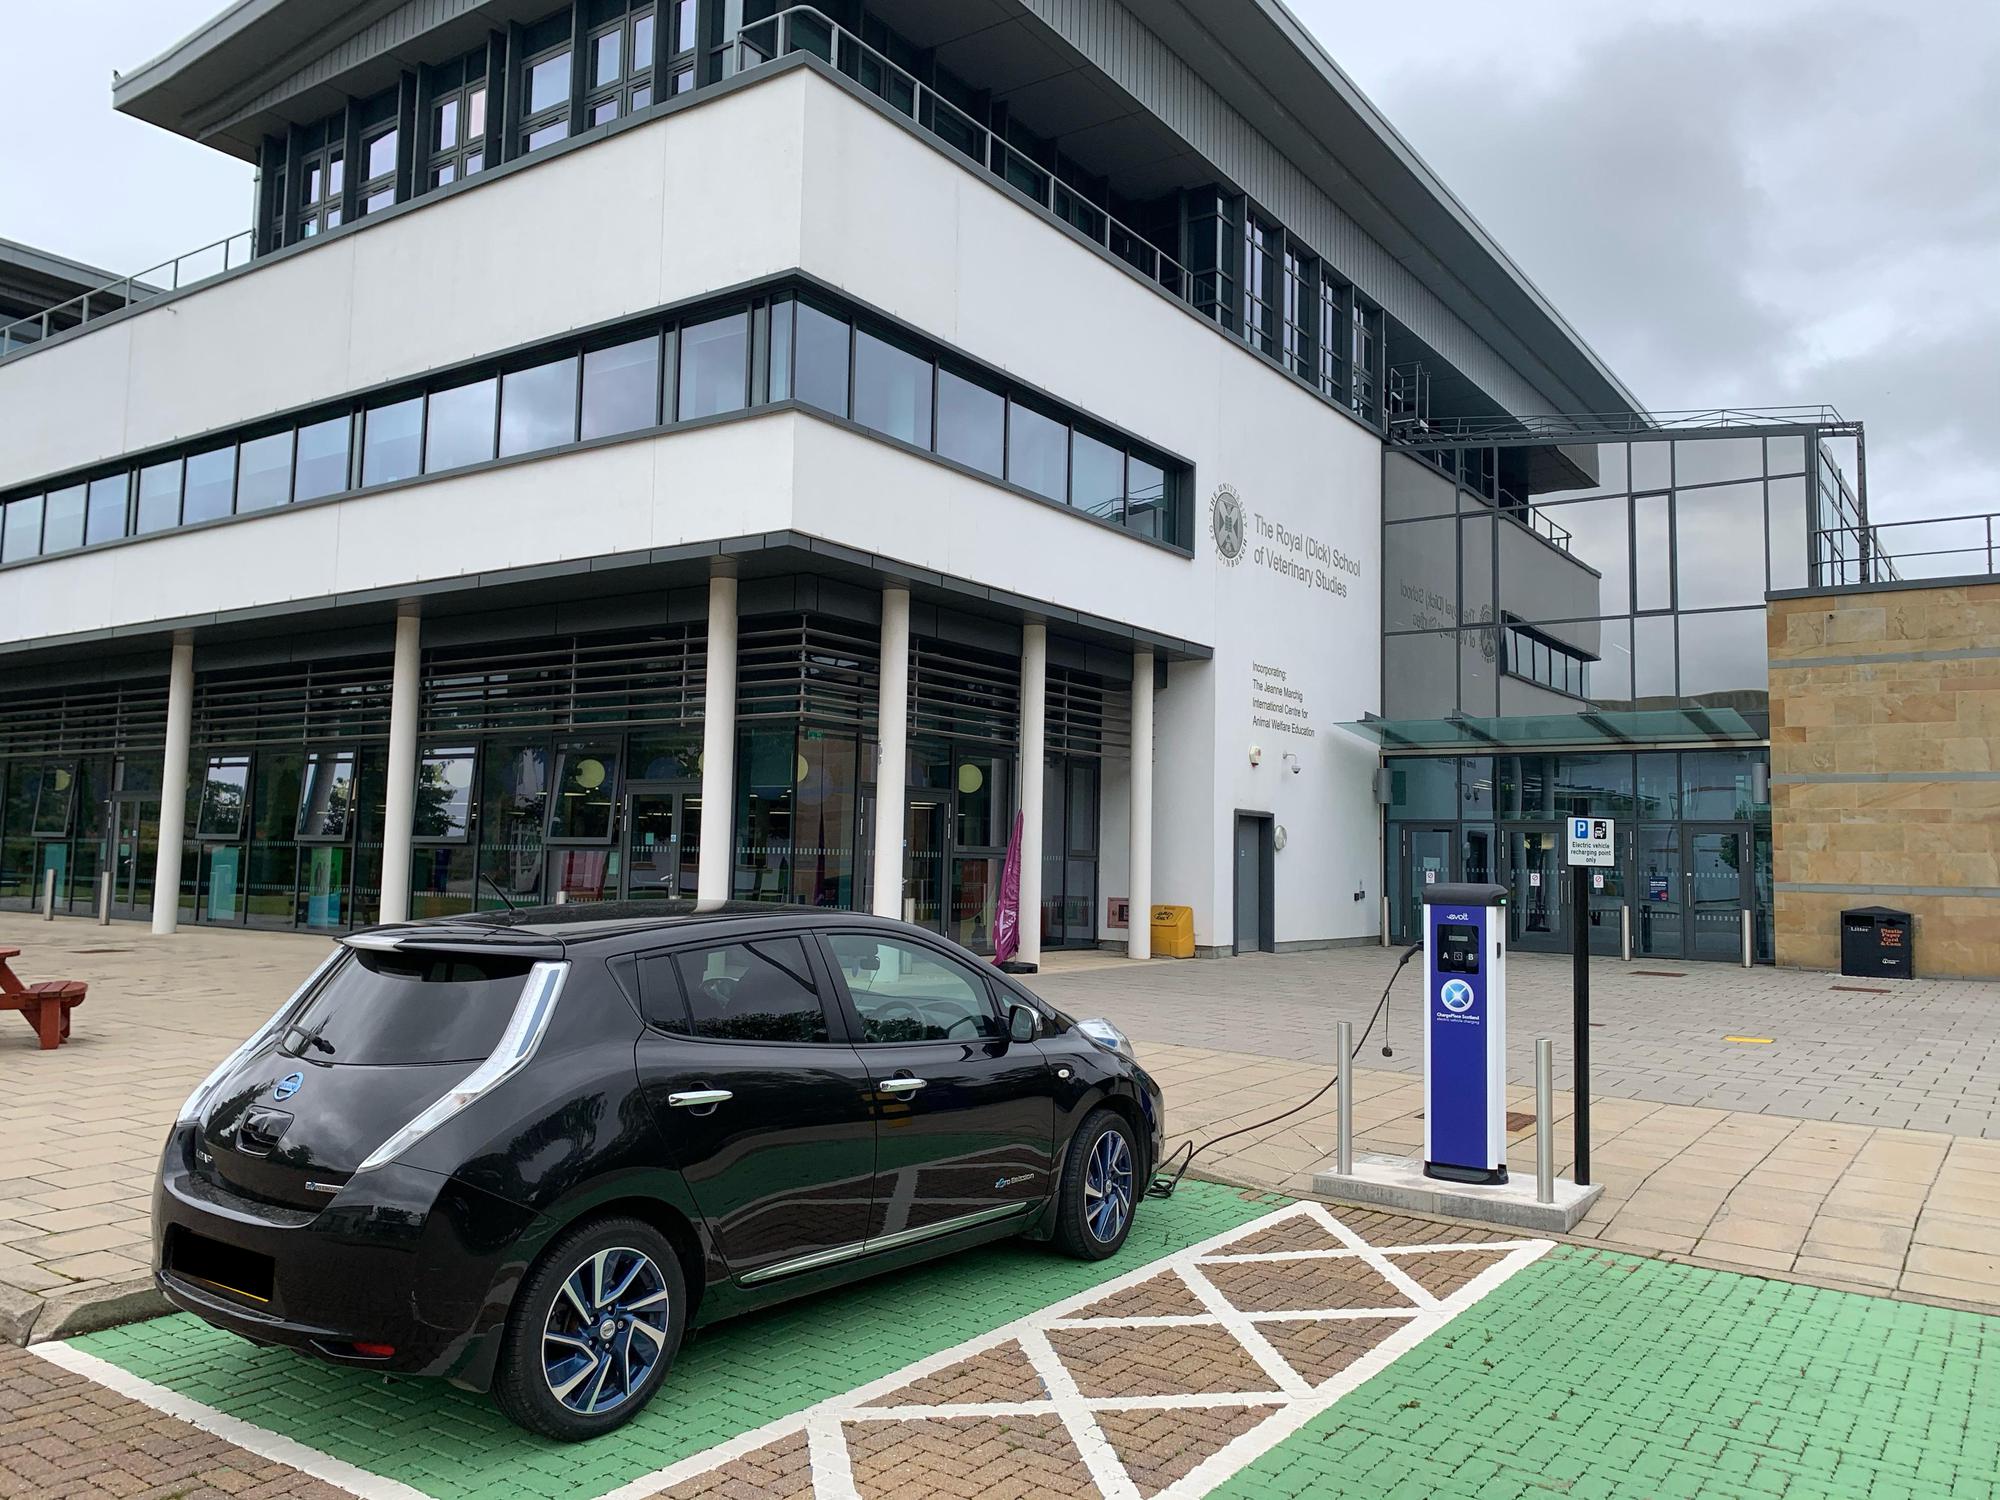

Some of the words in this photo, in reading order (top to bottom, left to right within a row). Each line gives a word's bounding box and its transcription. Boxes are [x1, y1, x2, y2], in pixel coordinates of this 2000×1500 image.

[1254, 513, 1273, 539] The
[1276, 523, 1303, 552] Royal
[1305, 536, 1331, 568] (Dick)
[1332, 549, 1361, 577] School
[1254, 546, 1264, 565] of
[1266, 547, 1313, 588] Veterinary
[1315, 569, 1347, 598] Studies
[1252, 678, 1263, 691] The
[1264, 682, 1283, 696] Jeanne
[1283, 686, 1304, 703] Marchig
[1252, 697, 1284, 713] International
[1284, 704, 1301, 717] Centre
[1301, 708, 1309, 718] for
[1252, 715, 1270, 728] Animal
[1271, 719, 1291, 732] Welfare
[1292, 723, 1316, 737] Education
[1577, 821, 1586, 837] P
[1570, 849, 1597, 857] recharging
[1572, 841, 1592, 849] Electric
[1585, 856, 1597, 864] only
[1442, 951, 1449, 959] A
[1468, 953, 1474, 961] B
